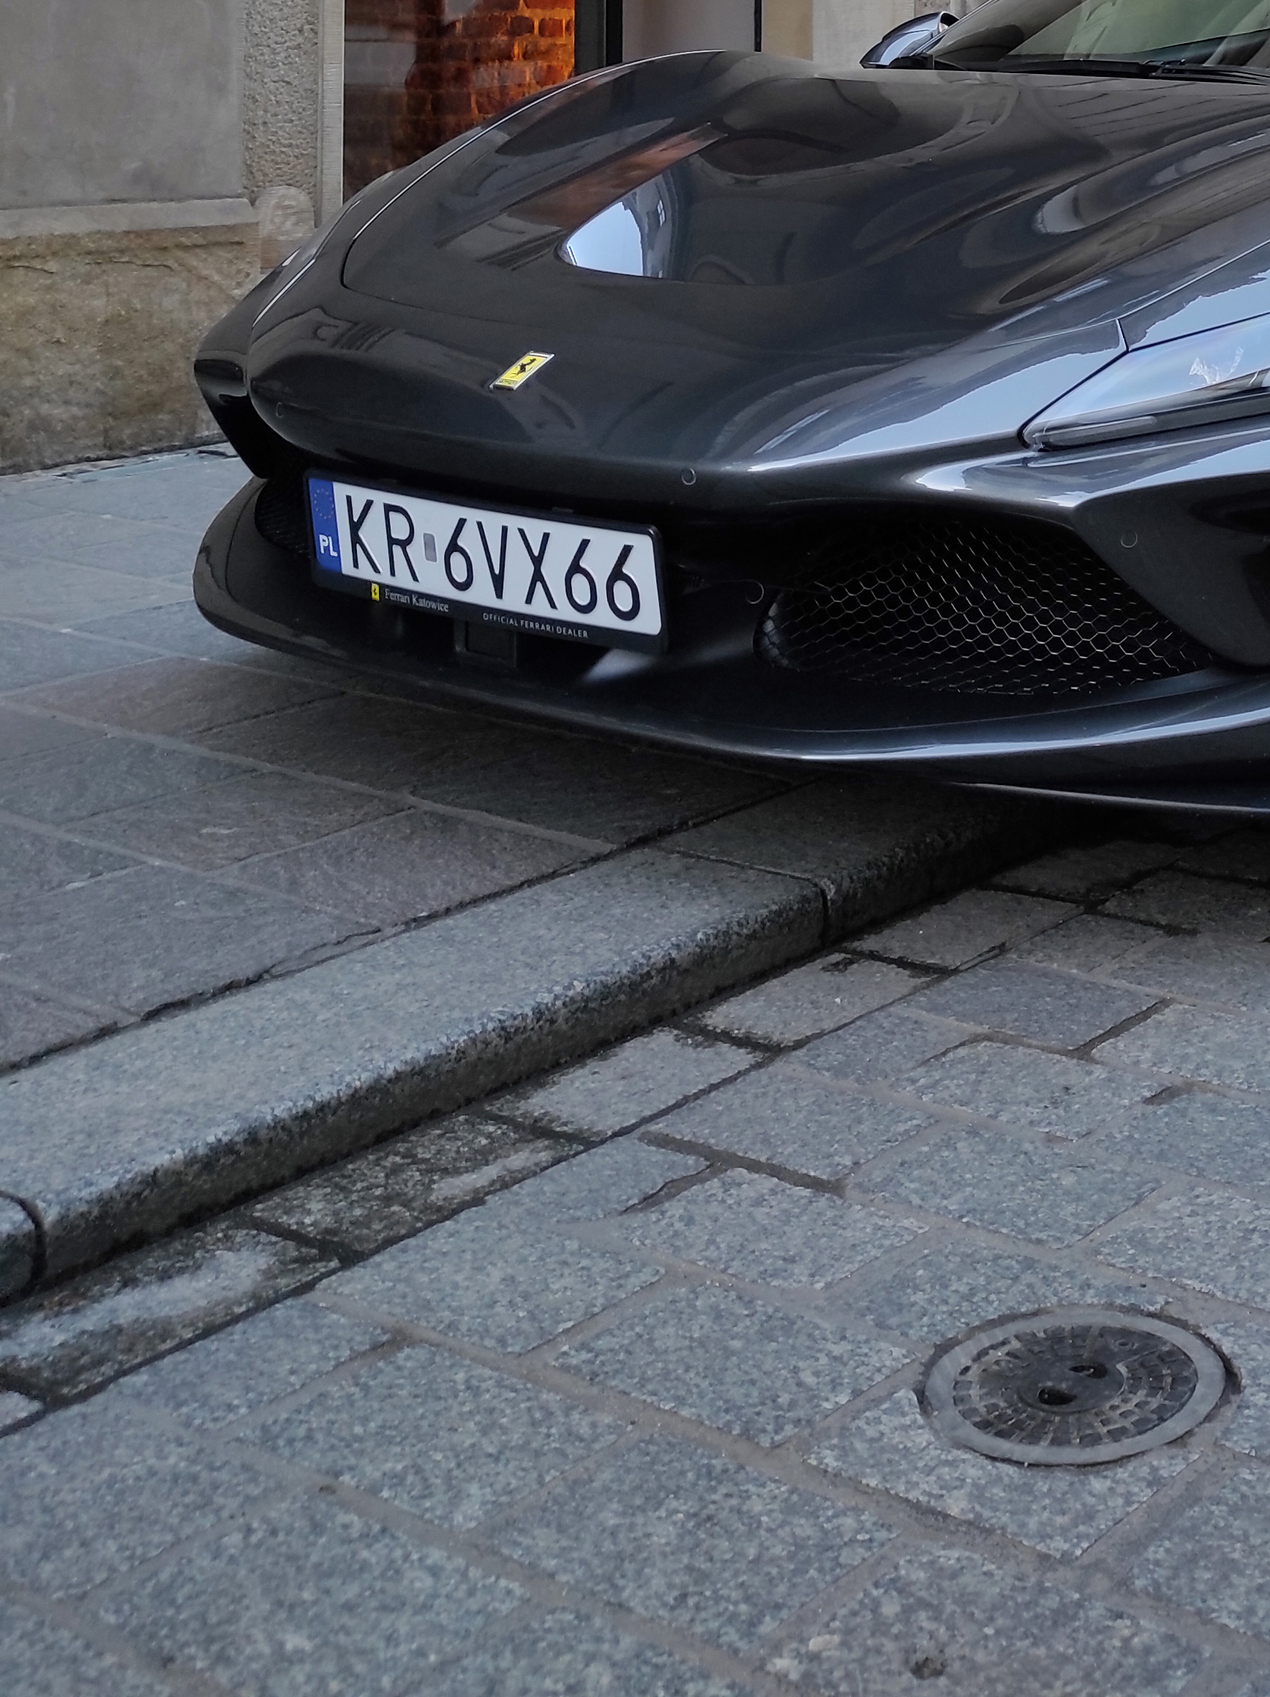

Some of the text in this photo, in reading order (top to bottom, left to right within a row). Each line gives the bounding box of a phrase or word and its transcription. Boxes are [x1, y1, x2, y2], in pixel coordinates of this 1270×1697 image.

[319, 534, 338, 558] PL
[346, 495, 641, 620] KR 6VX66
[412, 594, 449, 613] Katowice
[482, 612, 589, 639] OFFICIAL FERRARI DEALER
